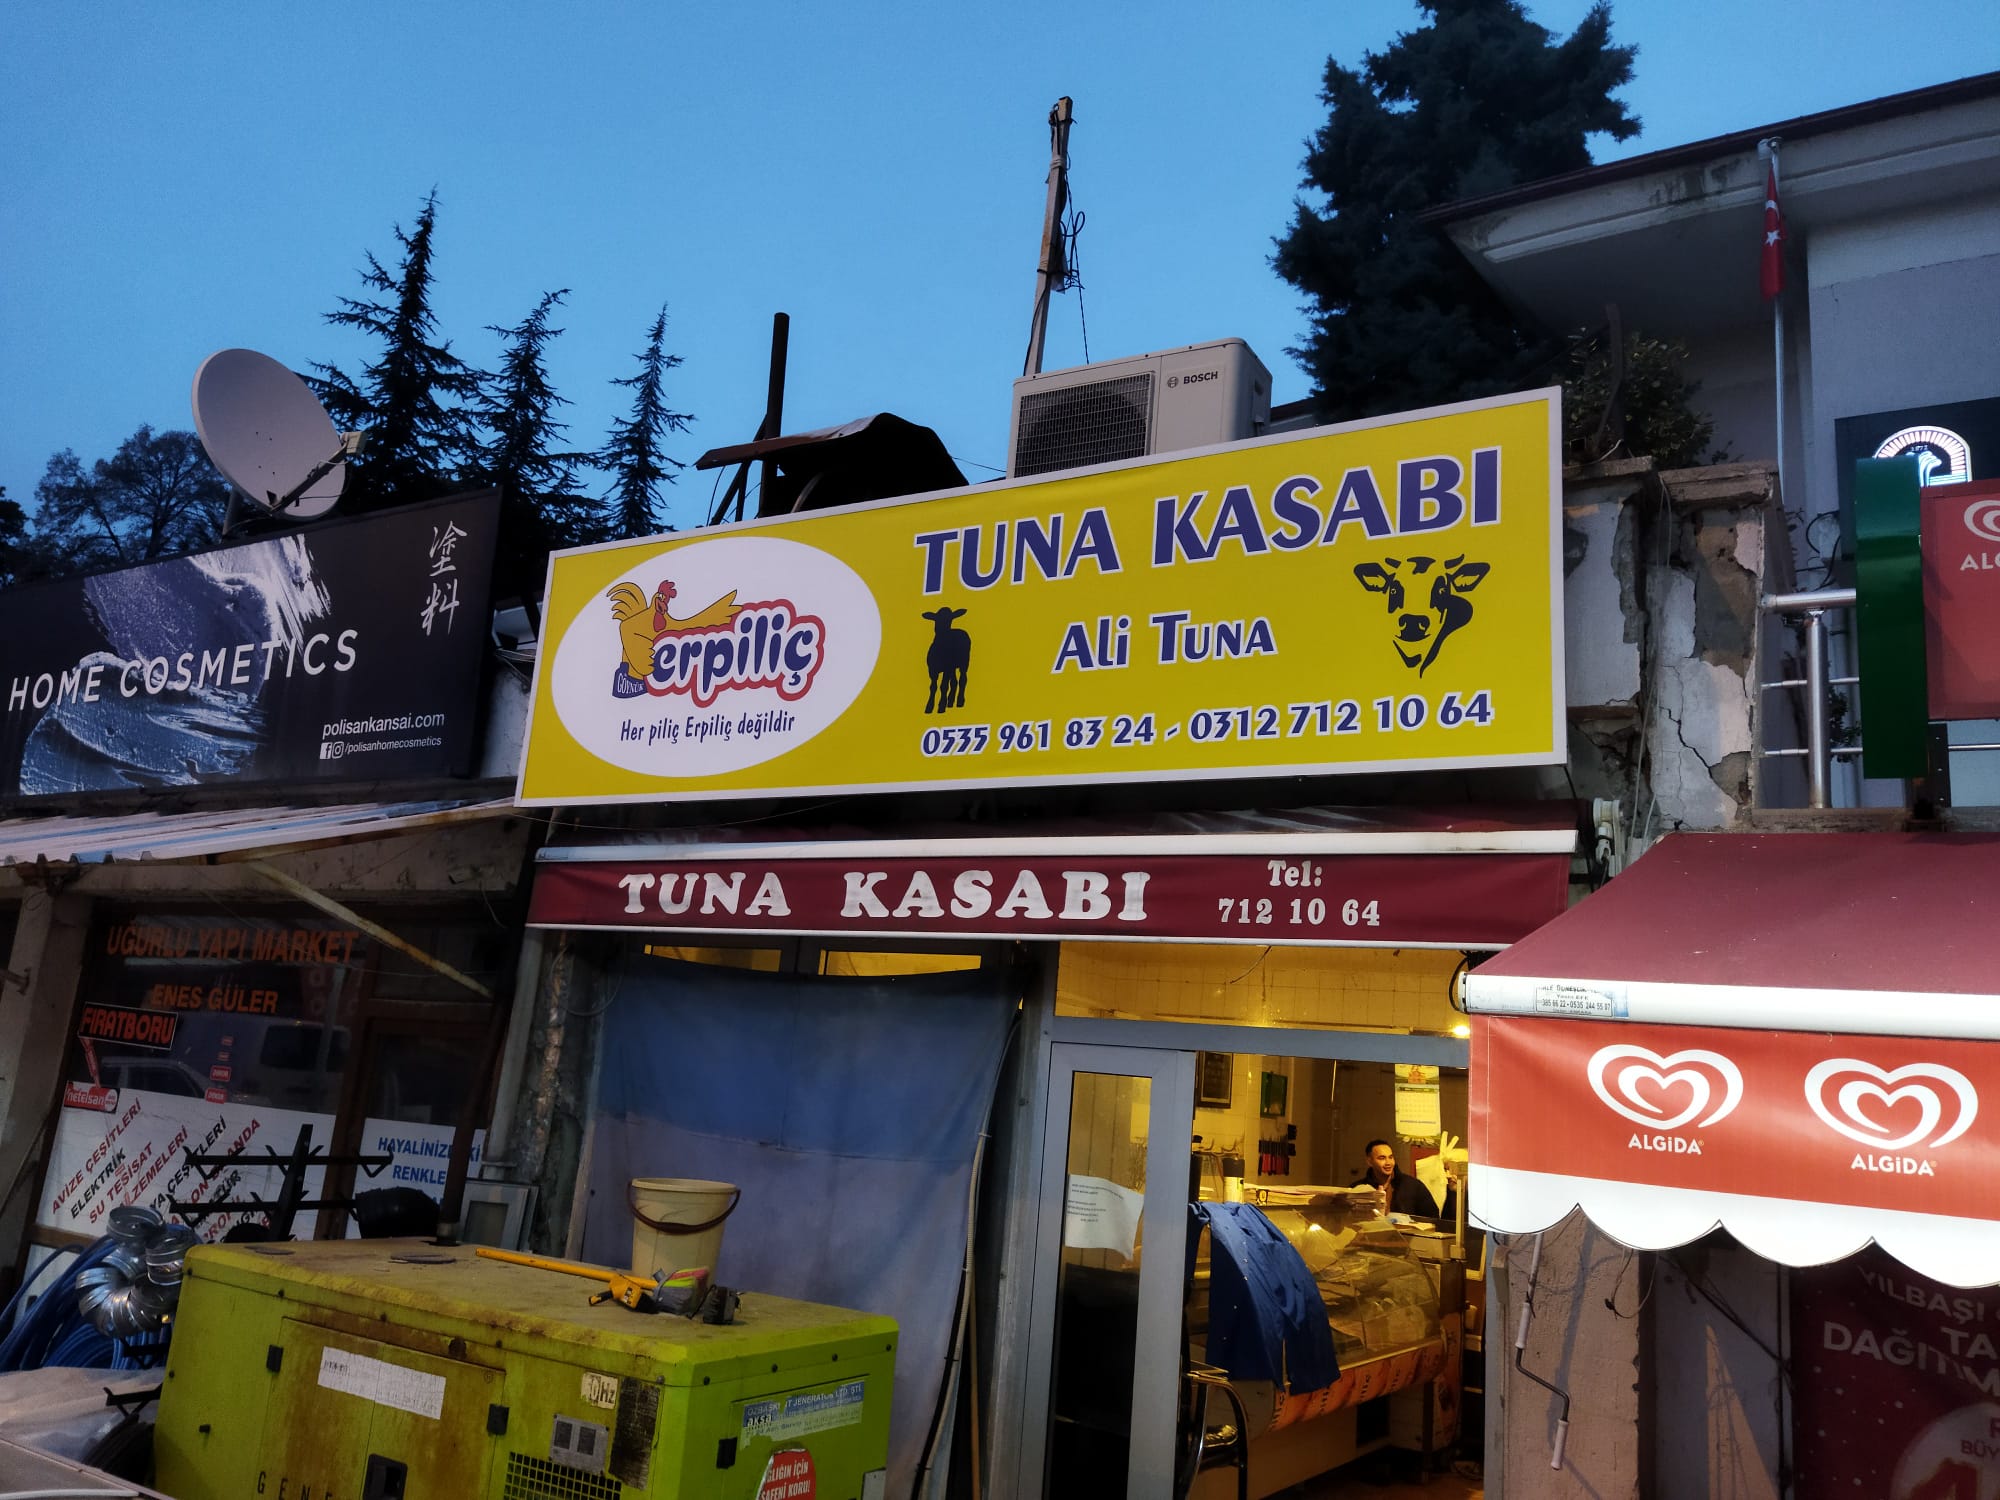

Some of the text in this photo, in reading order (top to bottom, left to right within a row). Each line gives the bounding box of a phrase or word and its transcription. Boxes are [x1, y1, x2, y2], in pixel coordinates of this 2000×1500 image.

[1183, 371, 1218, 385] BOSCH
[915, 447, 1500, 594] TUNA KASABI
[421, 520, 468, 636] 塗料
[8, 629, 358, 711] HOME COSMETICS
[654, 613, 813, 694] erpiliç
[1052, 616, 1131, 673] Ali
[322, 712, 445, 740] polisankansai.com
[620, 710, 795, 746] Her piliç Erpiliç değildir
[921, 724, 990, 757] 0535
[998, 720, 1051, 752] 961
[1065, 716, 1107, 748] 83
[1112, 713, 1156, 747] 24
[1190, 704, 1279, 742] 0312
[1286, 700, 1361, 737] 712
[1373, 695, 1428, 732] 10
[1438, 690, 1494, 728] 64
[618, 869, 1151, 921] TUNA KASABI
[1268, 860, 1322, 887] Tel:
[1218, 898, 1380, 926] 712 10 64
[197, 927, 247, 960] YAPI
[251, 929, 360, 963] MARKET
[80, 1007, 175, 1045] FIRATBORU
[152, 983, 203, 1009] ENES
[208, 982, 279, 1014] GÜLER
[52, 1169, 84, 1214] AVİZE
[86, 1098, 141, 1172] ÇEŞİTLERİ
[70, 1148, 126, 1218] ELEKTRİK
[89, 1202, 106, 1223] SU
[107, 1143, 153, 1201] TESİSAT
[122, 1125, 188, 1207] LZEMELERİ
[168, 1115, 226, 1193] ÇEŞTLERİ
[392, 1165, 446, 1185] RENKLE
[1857, 1265, 1985, 1324] YILBAŞI
